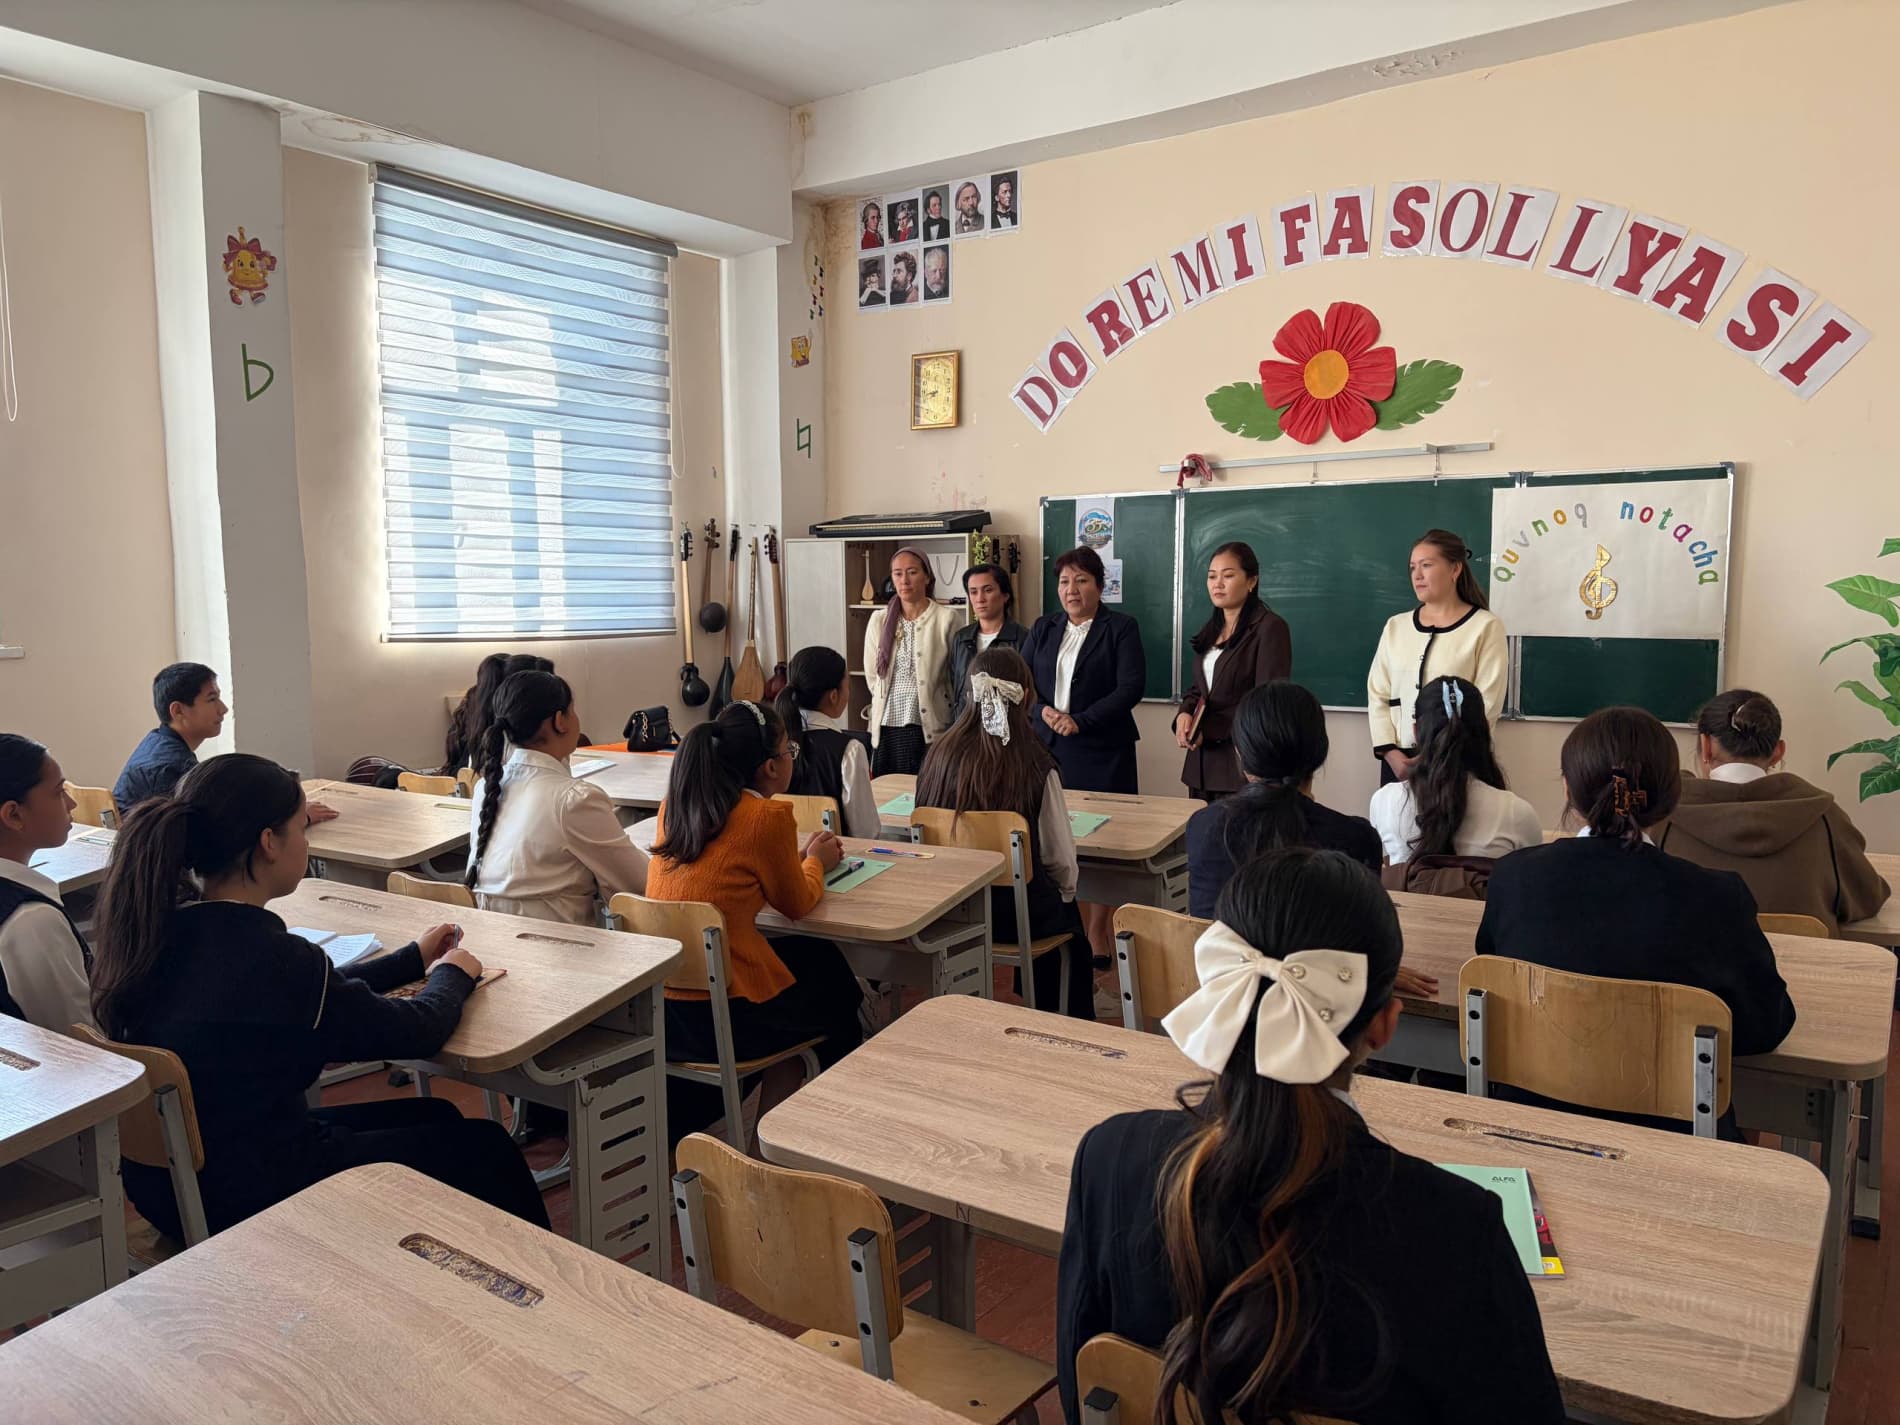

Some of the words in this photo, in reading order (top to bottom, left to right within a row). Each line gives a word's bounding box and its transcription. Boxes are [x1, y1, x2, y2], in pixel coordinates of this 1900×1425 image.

[1013, 341, 1088, 428] DO
[1086, 268, 1169, 357] RE
[1170, 223, 1254, 304] MI
[1280, 195, 1369, 266] FA
[1390, 186, 1538, 262] SOL
[1549, 205, 1726, 323] LYA
[1726, 283, 1852, 386] SI
[1493, 503, 1588, 583] Quvnoq
[1619, 501, 1719, 585] notacha
